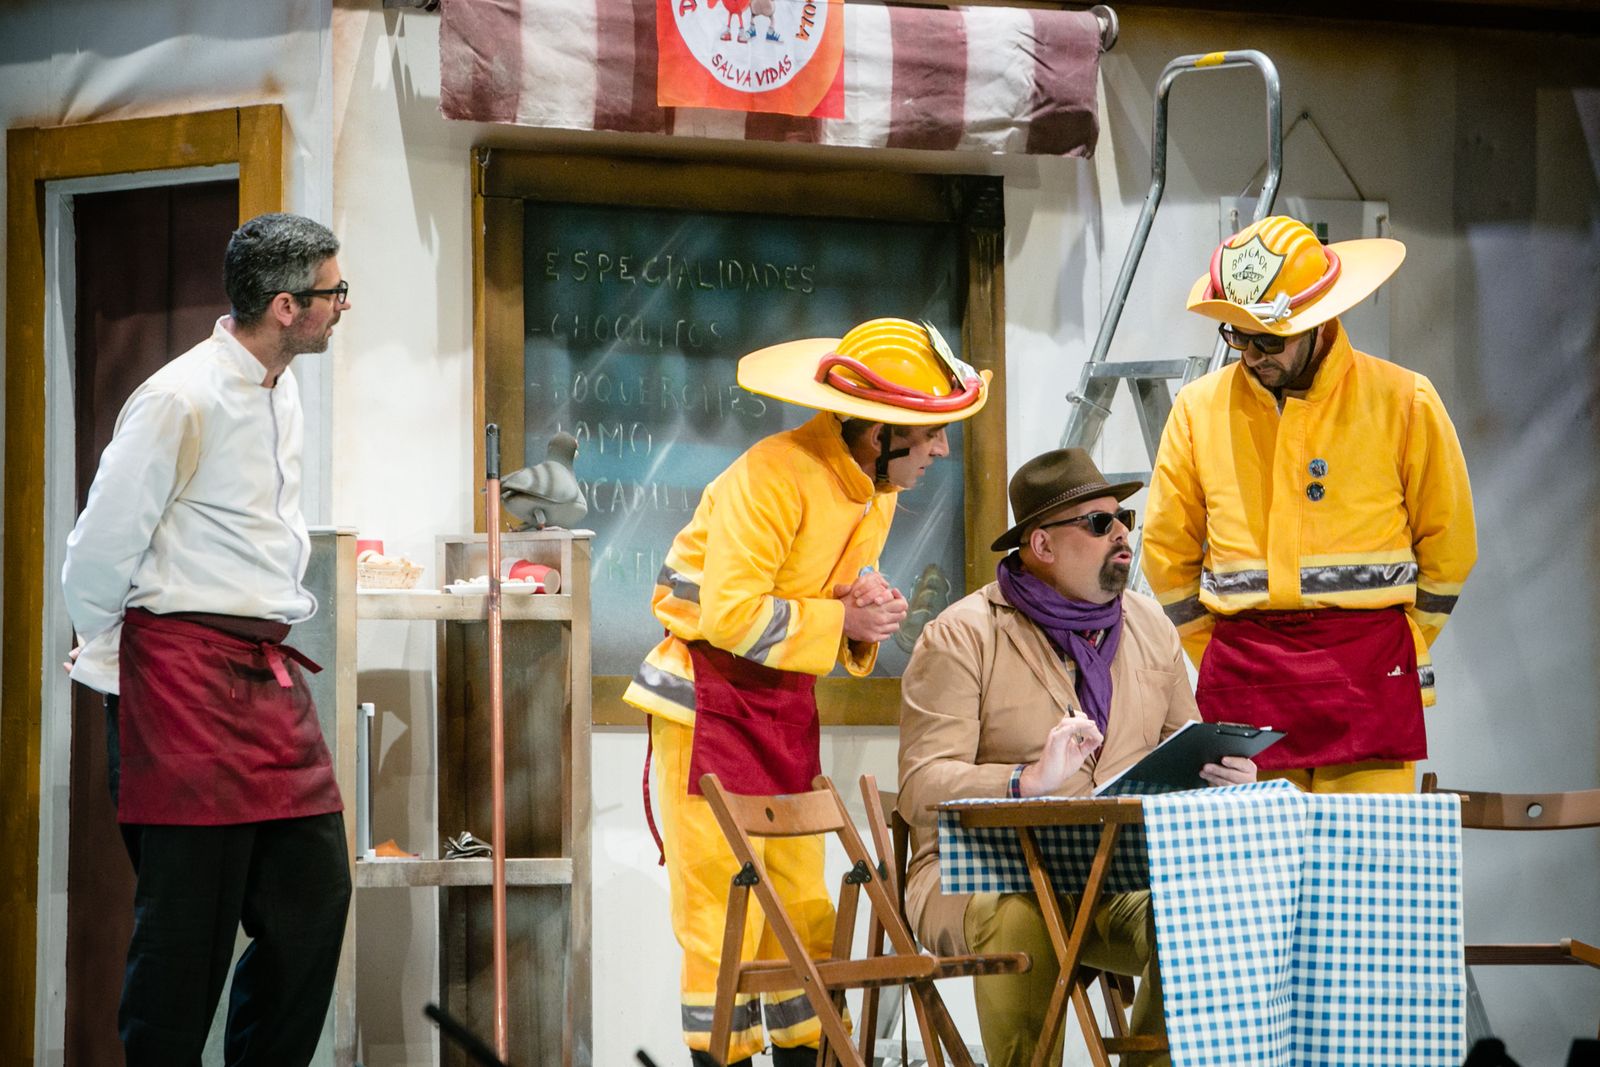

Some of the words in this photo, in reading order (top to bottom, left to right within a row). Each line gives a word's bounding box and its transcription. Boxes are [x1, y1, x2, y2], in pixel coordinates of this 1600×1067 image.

[795, 1, 818, 41] OLA
[711, 54, 751, 87] SALVA
[755, 55, 792, 86] VIDAS
[546, 249, 816, 293] ESPECIALIDADES
[1232, 247, 1267, 272] BRIGADA
[557, 420, 653, 458] OMO
[578, 477, 693, 515] OCADILL
